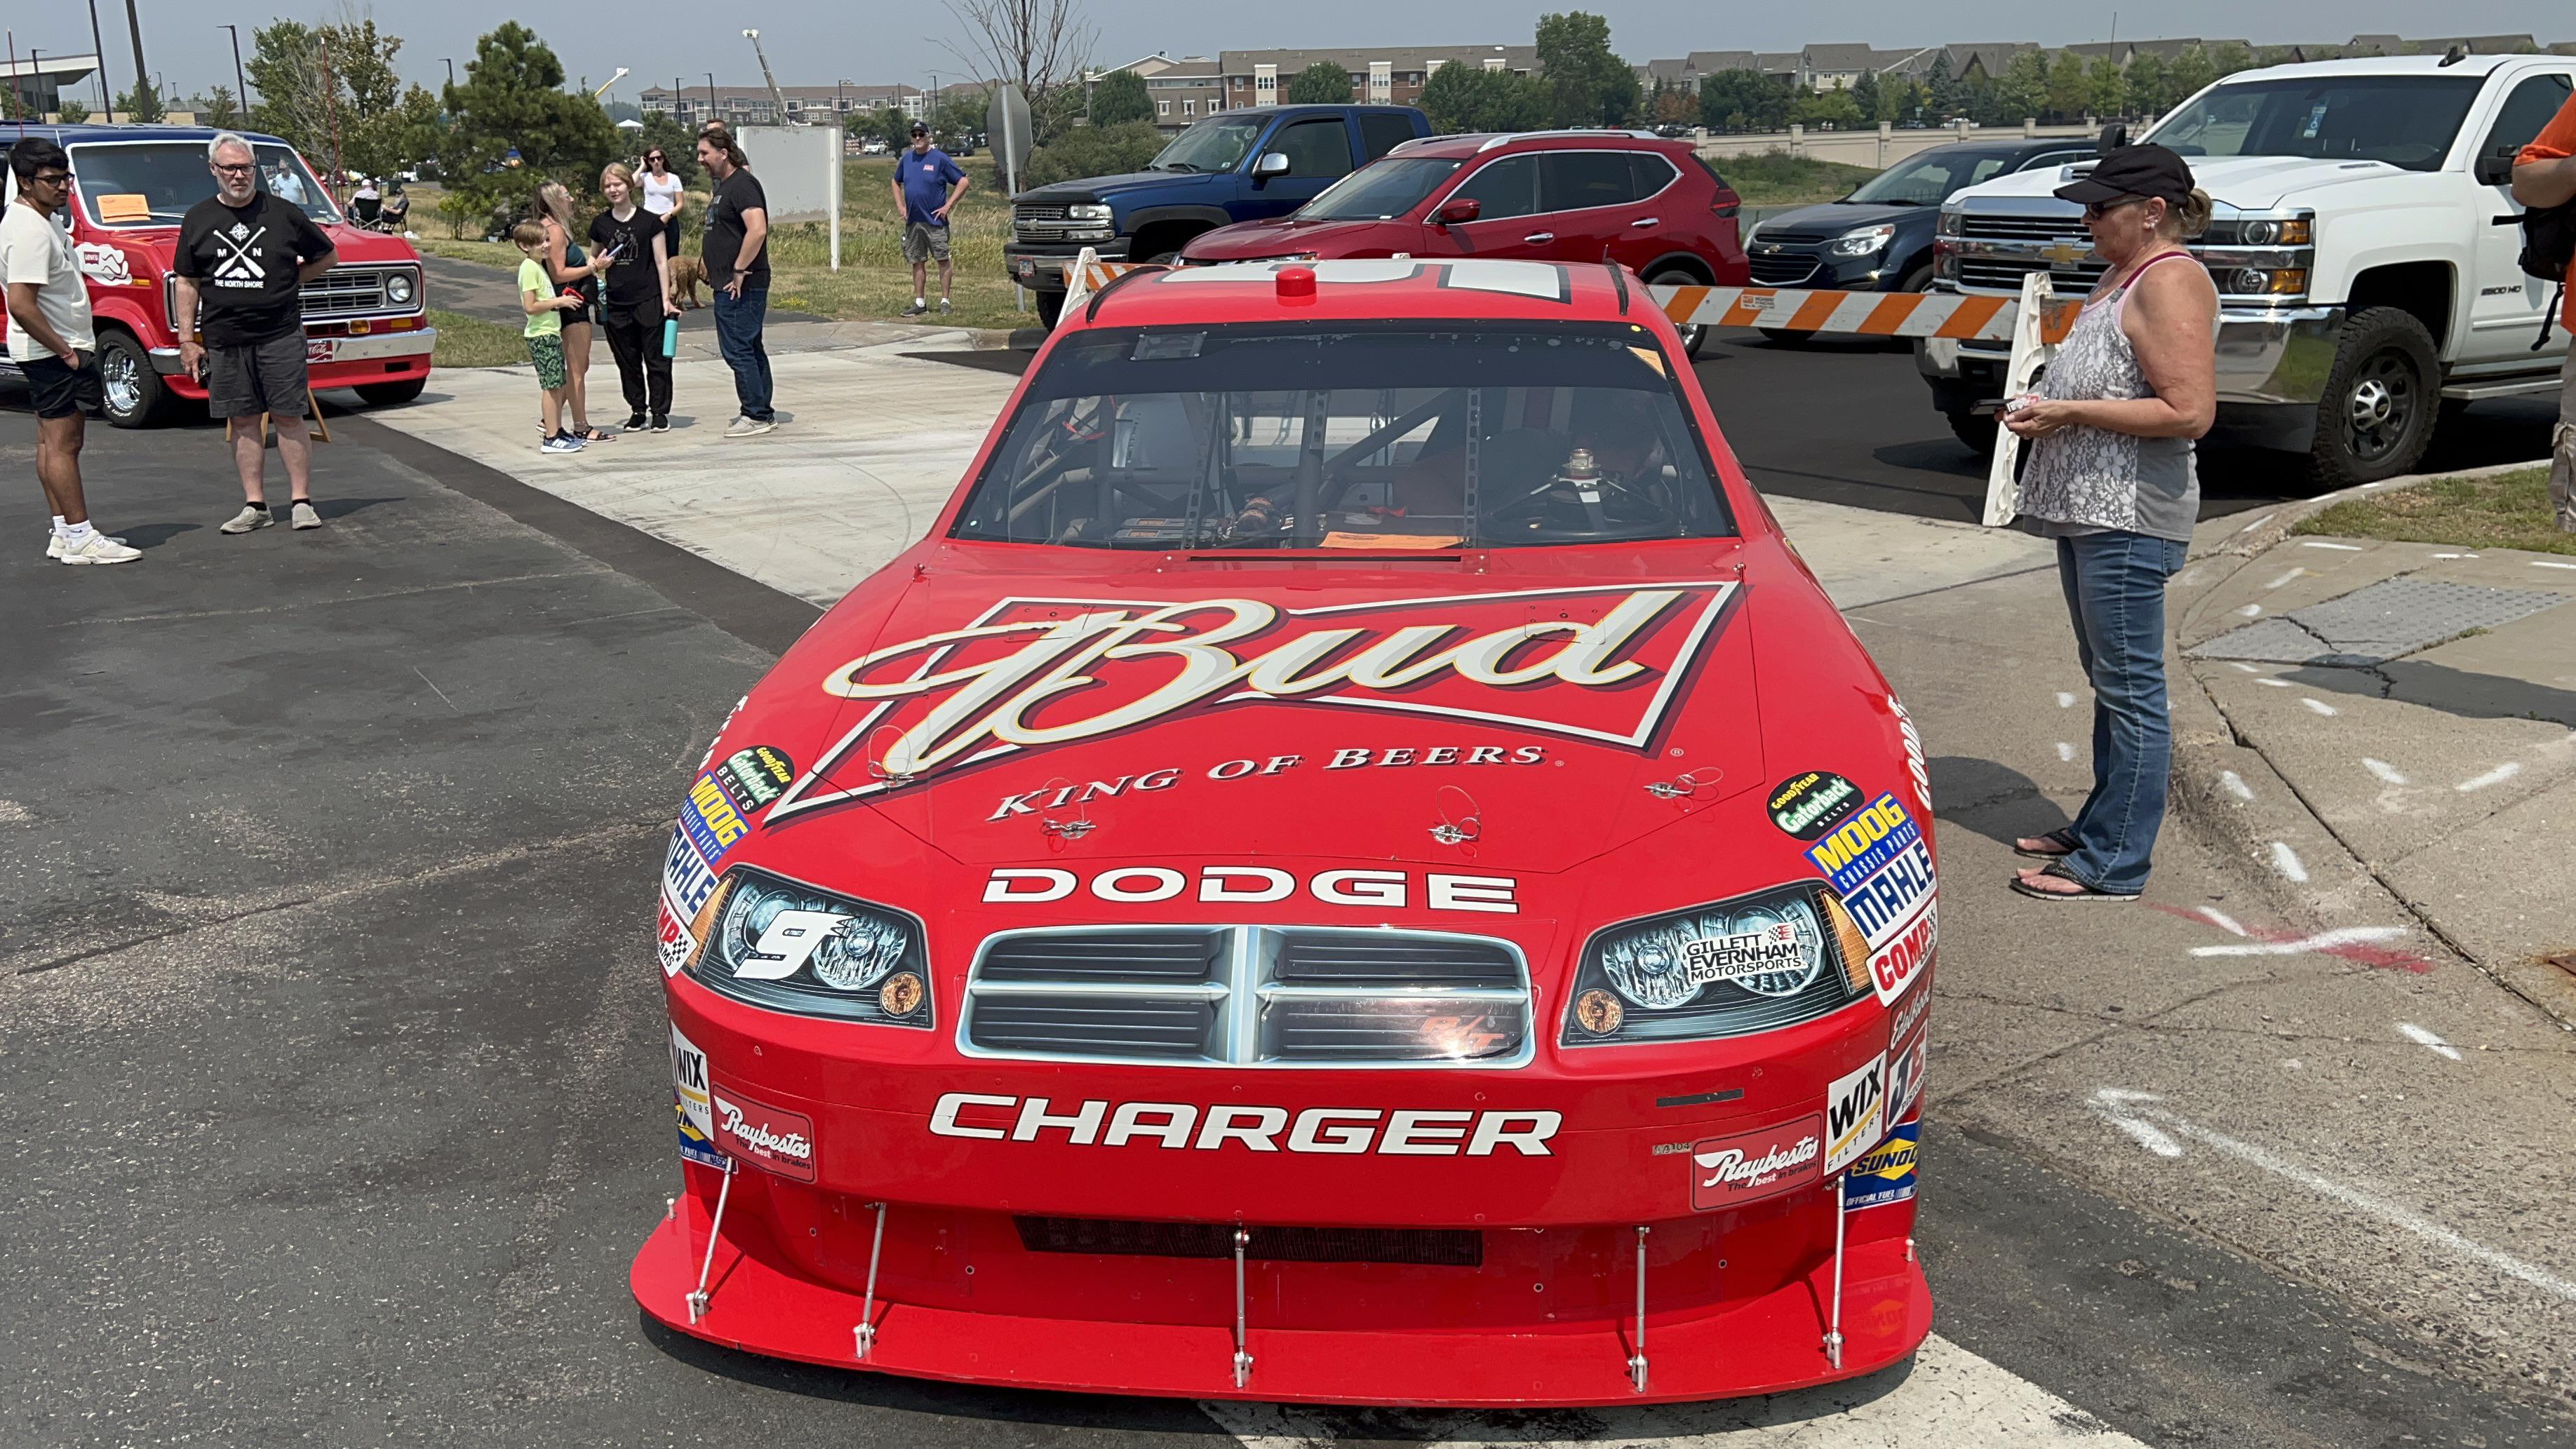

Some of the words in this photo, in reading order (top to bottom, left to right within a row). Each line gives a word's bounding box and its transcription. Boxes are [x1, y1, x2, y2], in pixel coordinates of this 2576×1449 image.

[217, 248, 227, 258] M
[253, 248, 262, 257] N
[822, 589, 1684, 774] Bud
[716, 766, 755, 810] BELTS
[728, 749, 780, 804] Gatorback
[985, 767, 1184, 823] KING
[1207, 754, 1303, 781] OF
[1324, 745, 1548, 771] BEERS
[1771, 772, 1820, 809] GOODYEAR
[689, 774, 749, 847] MOOG
[1776, 777, 1855, 833] Gatorback
[1816, 801, 1850, 827] BELTS
[696, 830, 720, 860] PARTS
[1811, 793, 1907, 877] MOOG
[1839, 847, 1886, 889] CHASSIS
[1886, 821, 1917, 853] PARTS
[982, 866, 1520, 914] DODGE
[1844, 840, 1935, 938] MAHLE
[732, 909, 855, 980] 9
[1686, 934, 1762, 956] GILLETT
[1689, 942, 1799, 971] EVERNHAM
[1691, 957, 1802, 982] MOTORSPORTS
[1874, 917, 1929, 992] COMP
[714, 1094, 811, 1159] Raybestos
[930, 1093, 1562, 1158] CHARGER
[1829, 1057, 1882, 1141] WIX
[754, 1146, 772, 1159] best
[781, 1156, 811, 1170] brakes
[1693, 1135, 1820, 1188] Raybestos
[1827, 1107, 1881, 1171] FILTERS
[1728, 1181, 1748, 1192] The
[1755, 1172, 1778, 1187] best
[1778, 1171, 1787, 1180] in
[1787, 1159, 1818, 1177] brakes
[1846, 1193, 1877, 1207] OFFICIAL
[1878, 1189, 1896, 1200] FUEL
